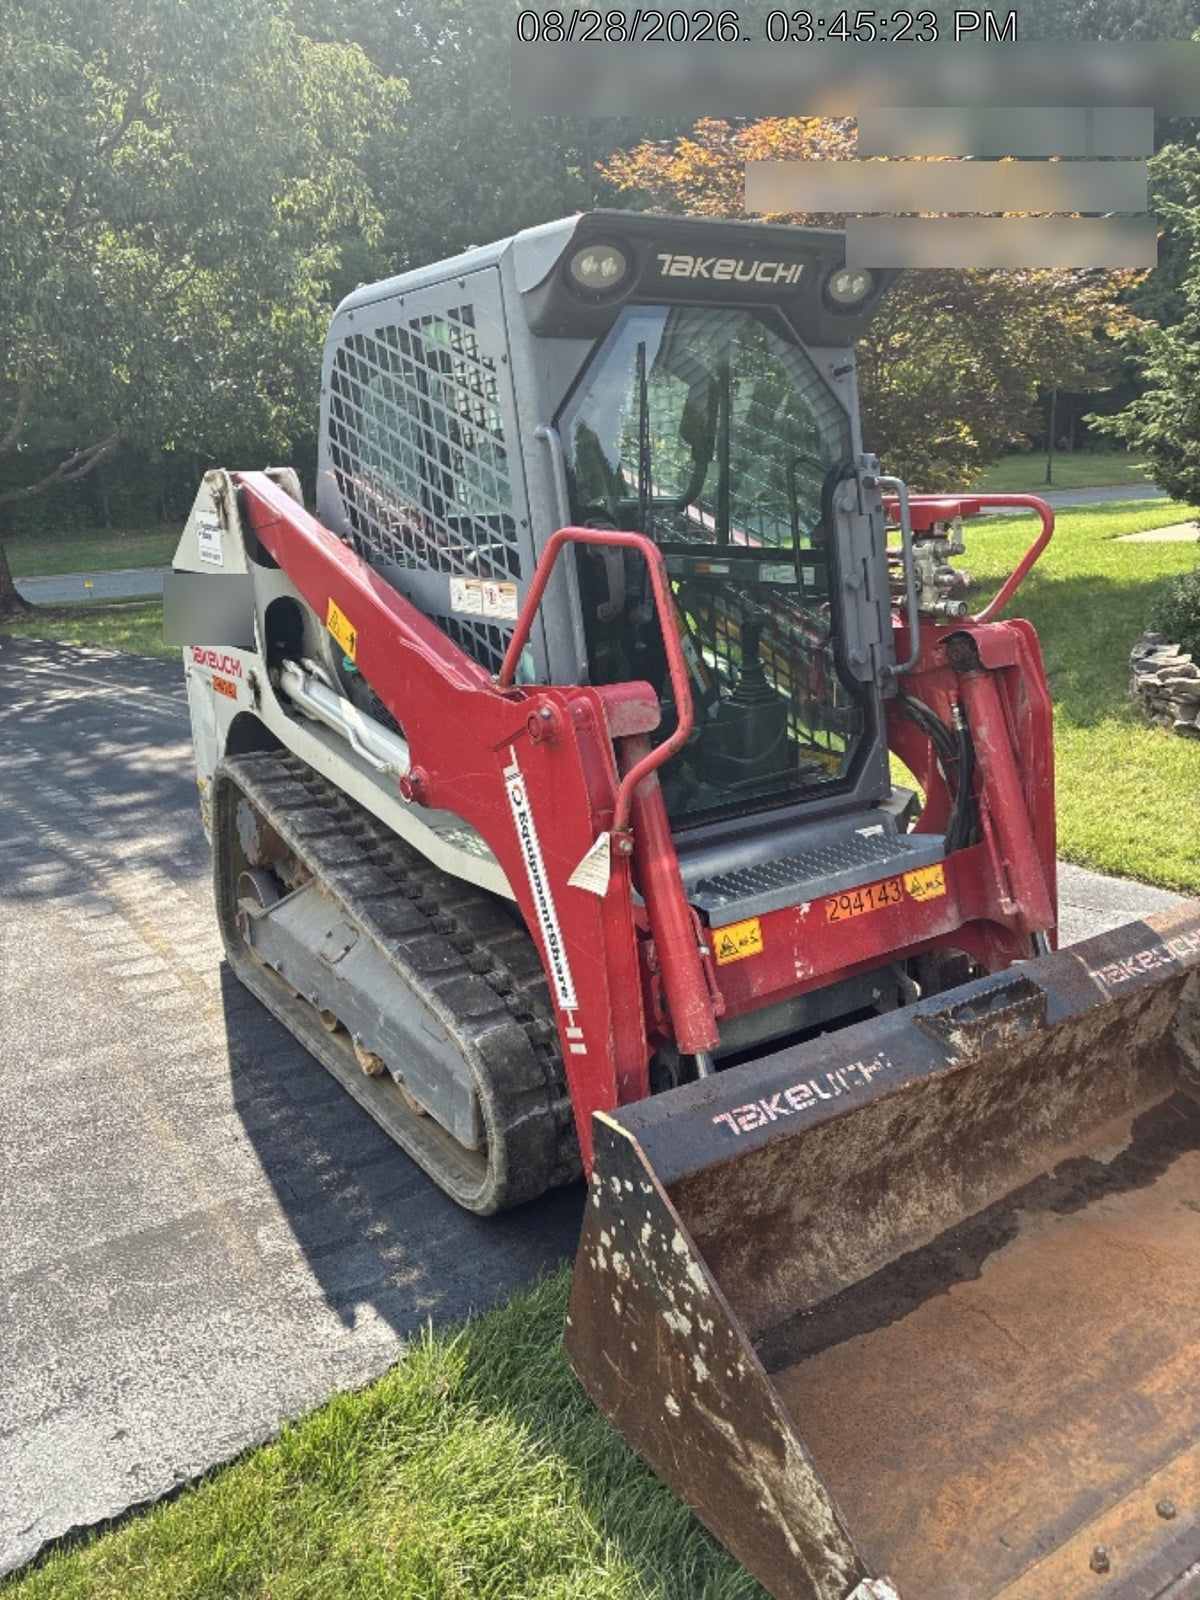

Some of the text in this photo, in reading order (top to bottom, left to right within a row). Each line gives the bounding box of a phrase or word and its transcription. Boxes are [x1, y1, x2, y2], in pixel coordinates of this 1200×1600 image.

[657, 253, 804, 284] TAKEUCHI
[518, 808, 569, 998] EquipmentShare
[828, 881, 902, 922] 294143
[711, 1052, 892, 1136] TAKEUCH
